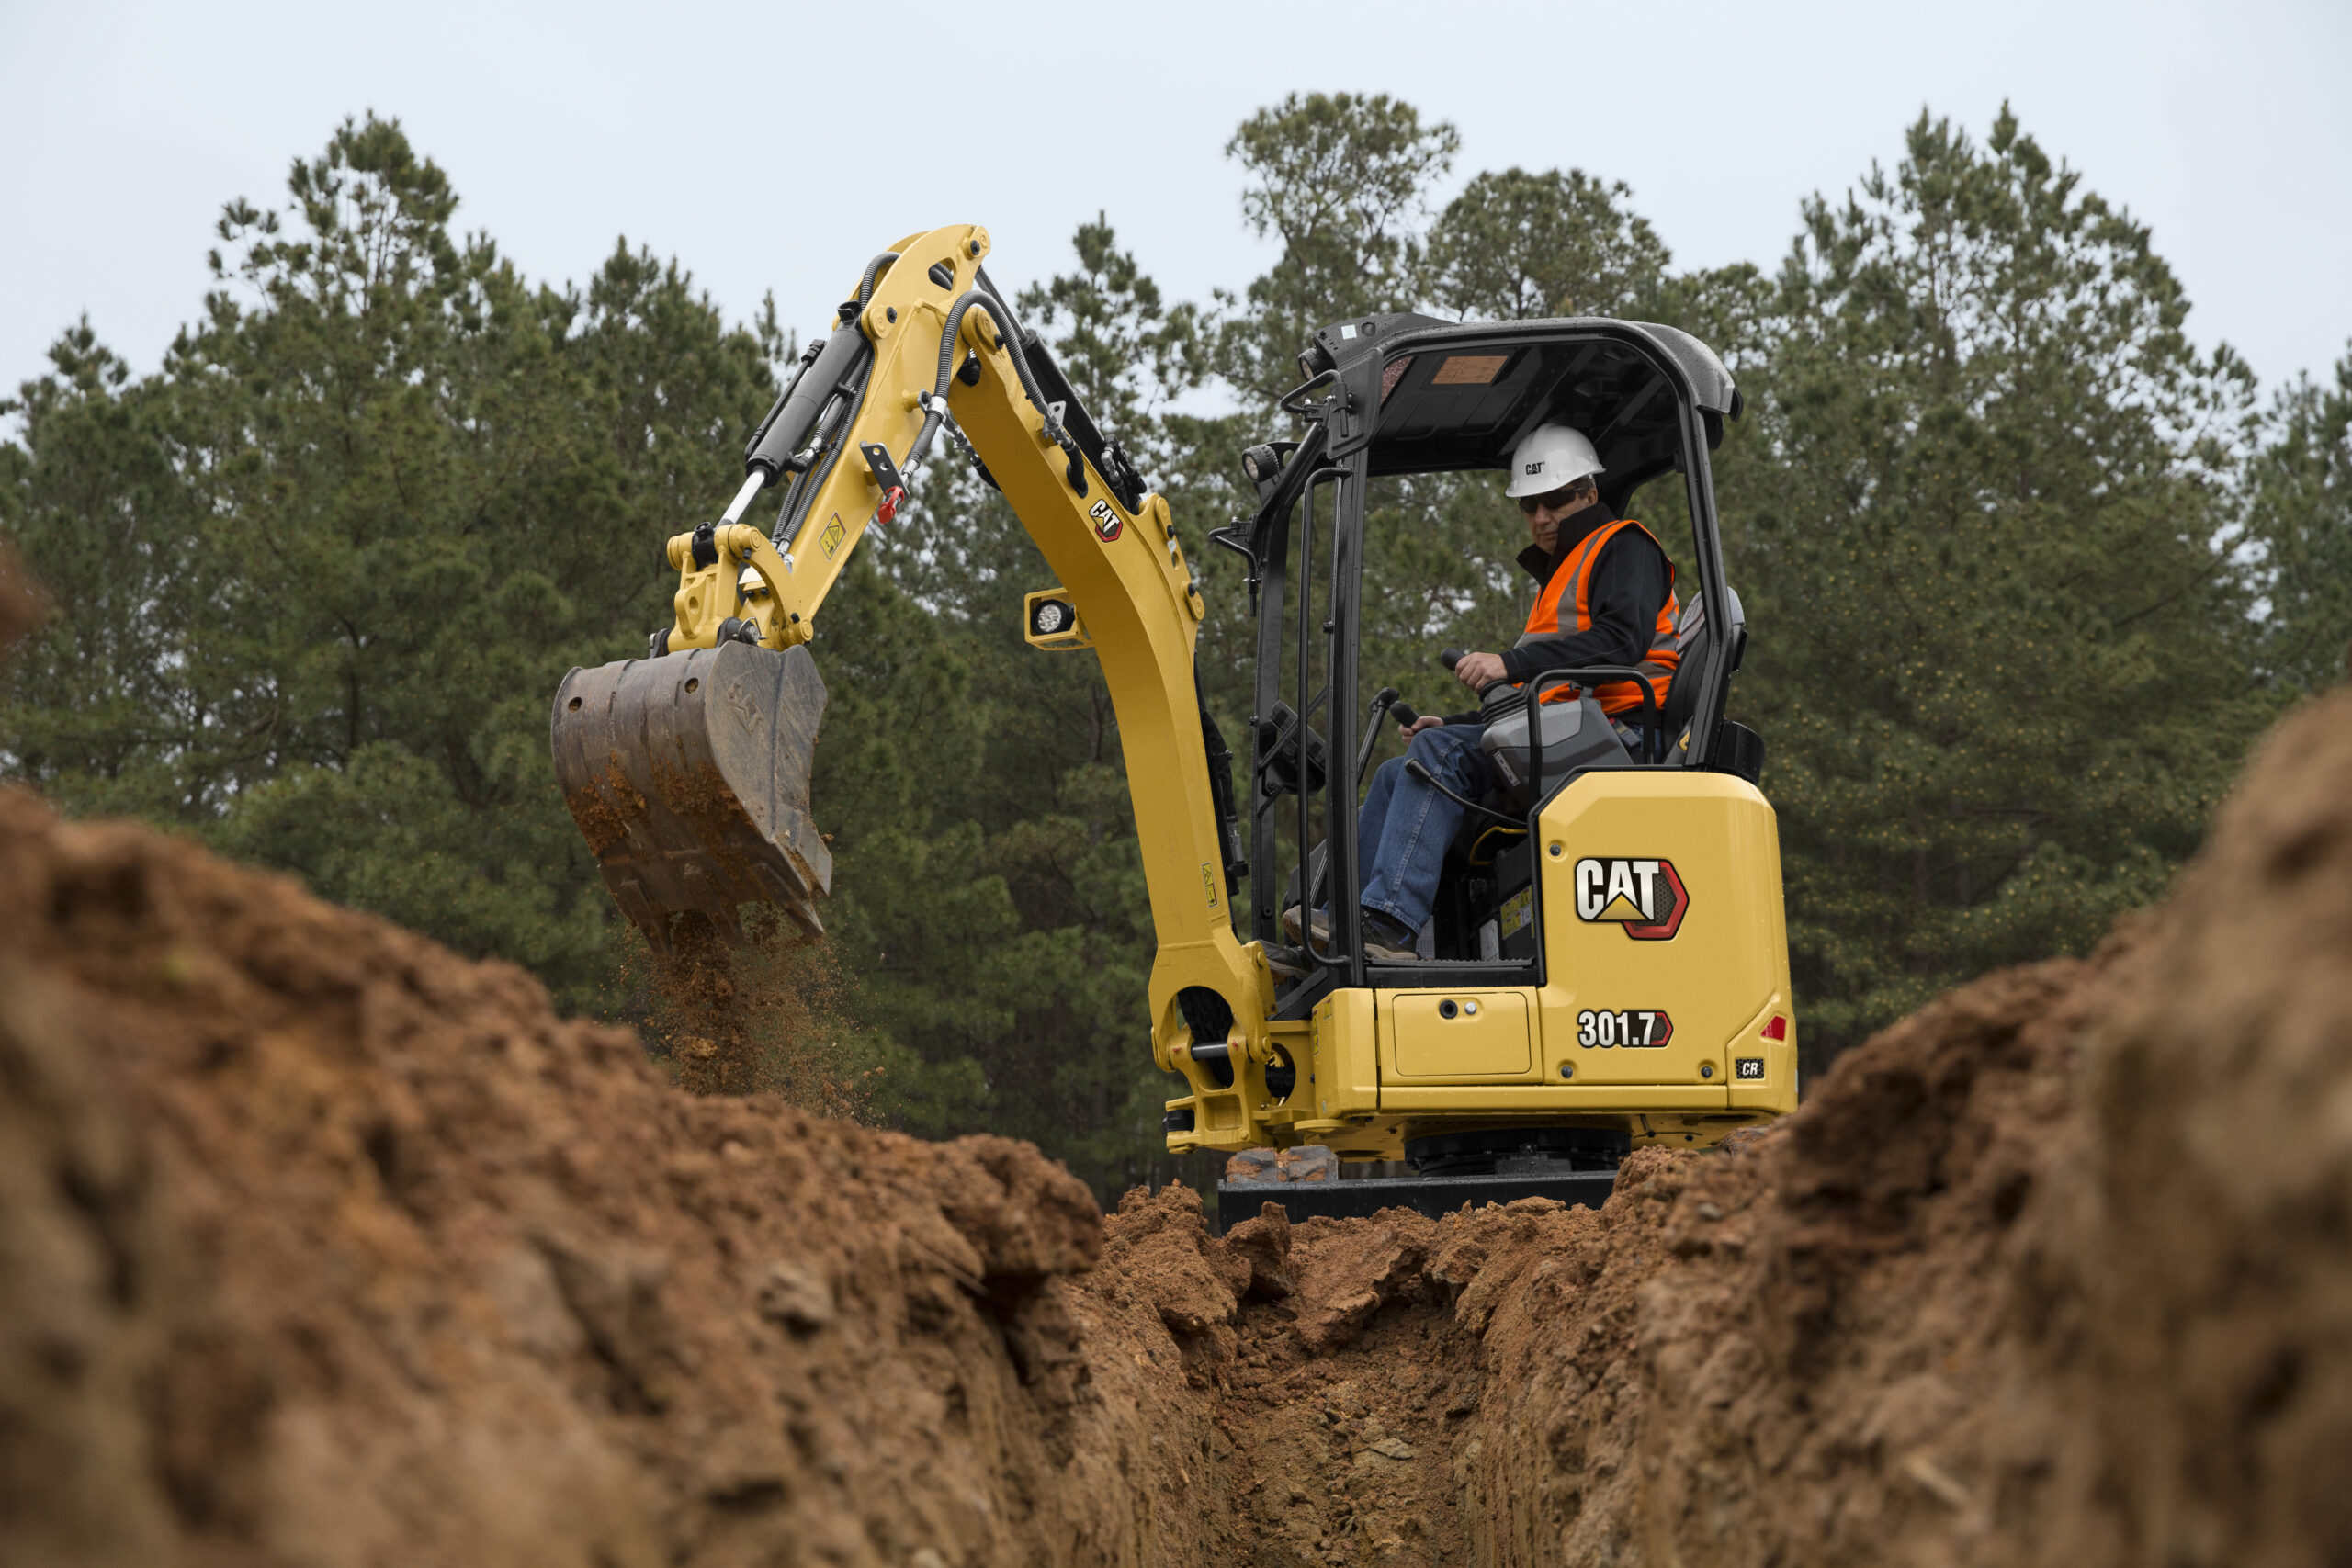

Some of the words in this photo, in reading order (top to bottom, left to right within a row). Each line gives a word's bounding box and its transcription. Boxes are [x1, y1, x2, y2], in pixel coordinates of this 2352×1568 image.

[1525, 462, 1543, 475] CAT
[1090, 499, 1121, 533] CAT
[1577, 859, 1660, 920] CAT
[1579, 1011, 1656, 1046] 301.7
[1742, 1062, 1758, 1076] CR
